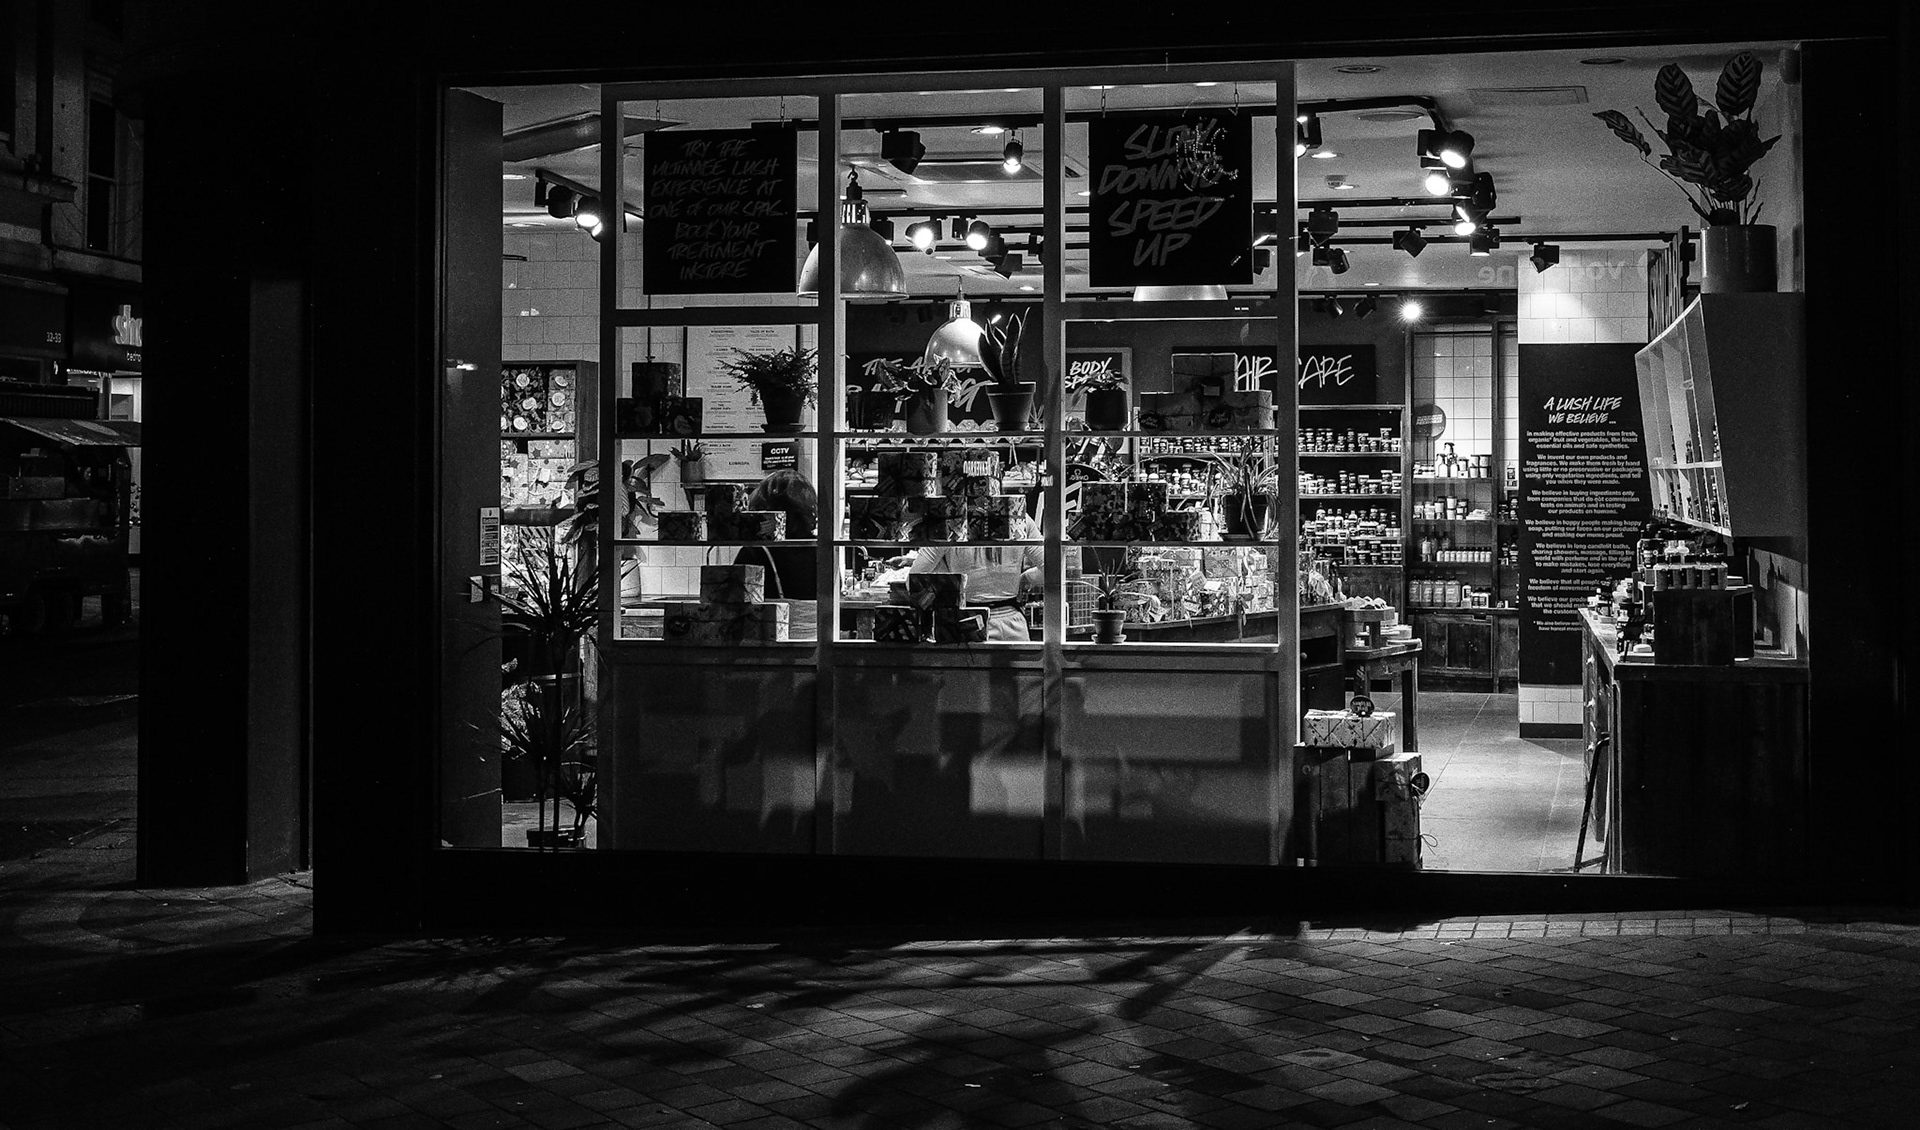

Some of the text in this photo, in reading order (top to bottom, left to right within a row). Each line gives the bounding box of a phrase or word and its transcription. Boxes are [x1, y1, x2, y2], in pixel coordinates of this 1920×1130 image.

[681, 139, 757, 157] TRY THE
[732, 157, 779, 176] LUSH
[1098, 158, 1185, 195] DOWN
[650, 178, 783, 197] EXPERIENCE AT
[649, 198, 788, 219] ONE OF OUR SPAS.
[1108, 196, 1225, 237] SPEED
[674, 220, 760, 240] BOOK YOUR
[666, 239, 777, 260] TREATMENT
[1133, 233, 1192, 267] UP
[679, 259, 751, 280] INSTORE
[46, 331, 62, 344] 32-33
[1070, 356, 1112, 376] BODY
[1237, 354, 1354, 391] AIR ARE
[1543, 396, 1622, 411] A LUSH LIFE
[1548, 412, 1565, 424] WE
[1566, 412, 1609, 424] BELIEVE
